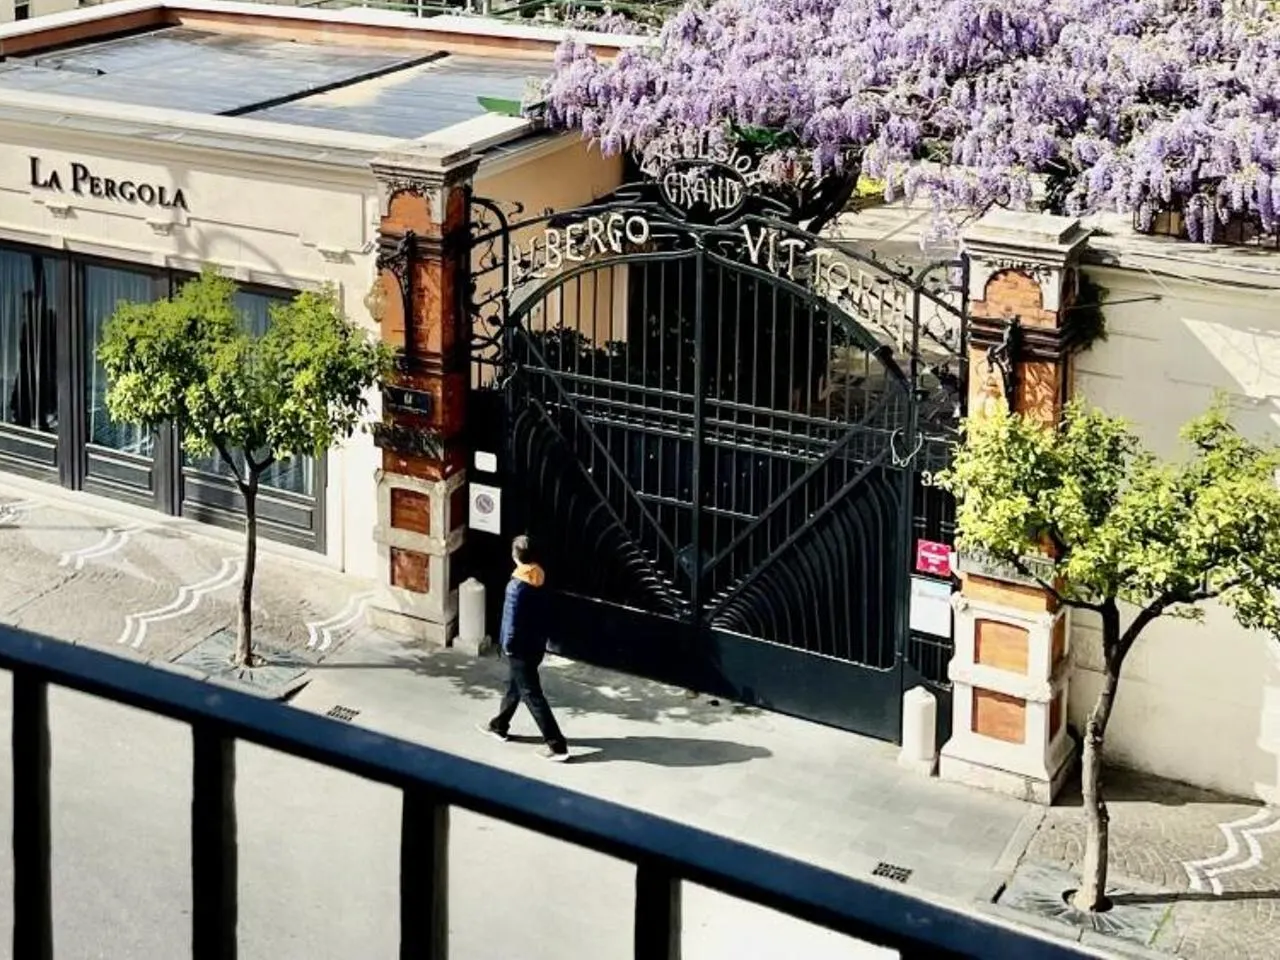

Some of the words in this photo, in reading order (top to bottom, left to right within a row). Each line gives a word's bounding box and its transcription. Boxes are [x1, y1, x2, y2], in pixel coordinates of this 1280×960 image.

[29, 156, 63, 191] LA
[70, 162, 190, 212] PERGOLA
[663, 171, 742, 212] GRAND
[507, 211, 650, 299] ALBERGO
[740, 224, 908, 356] VITTORIA
